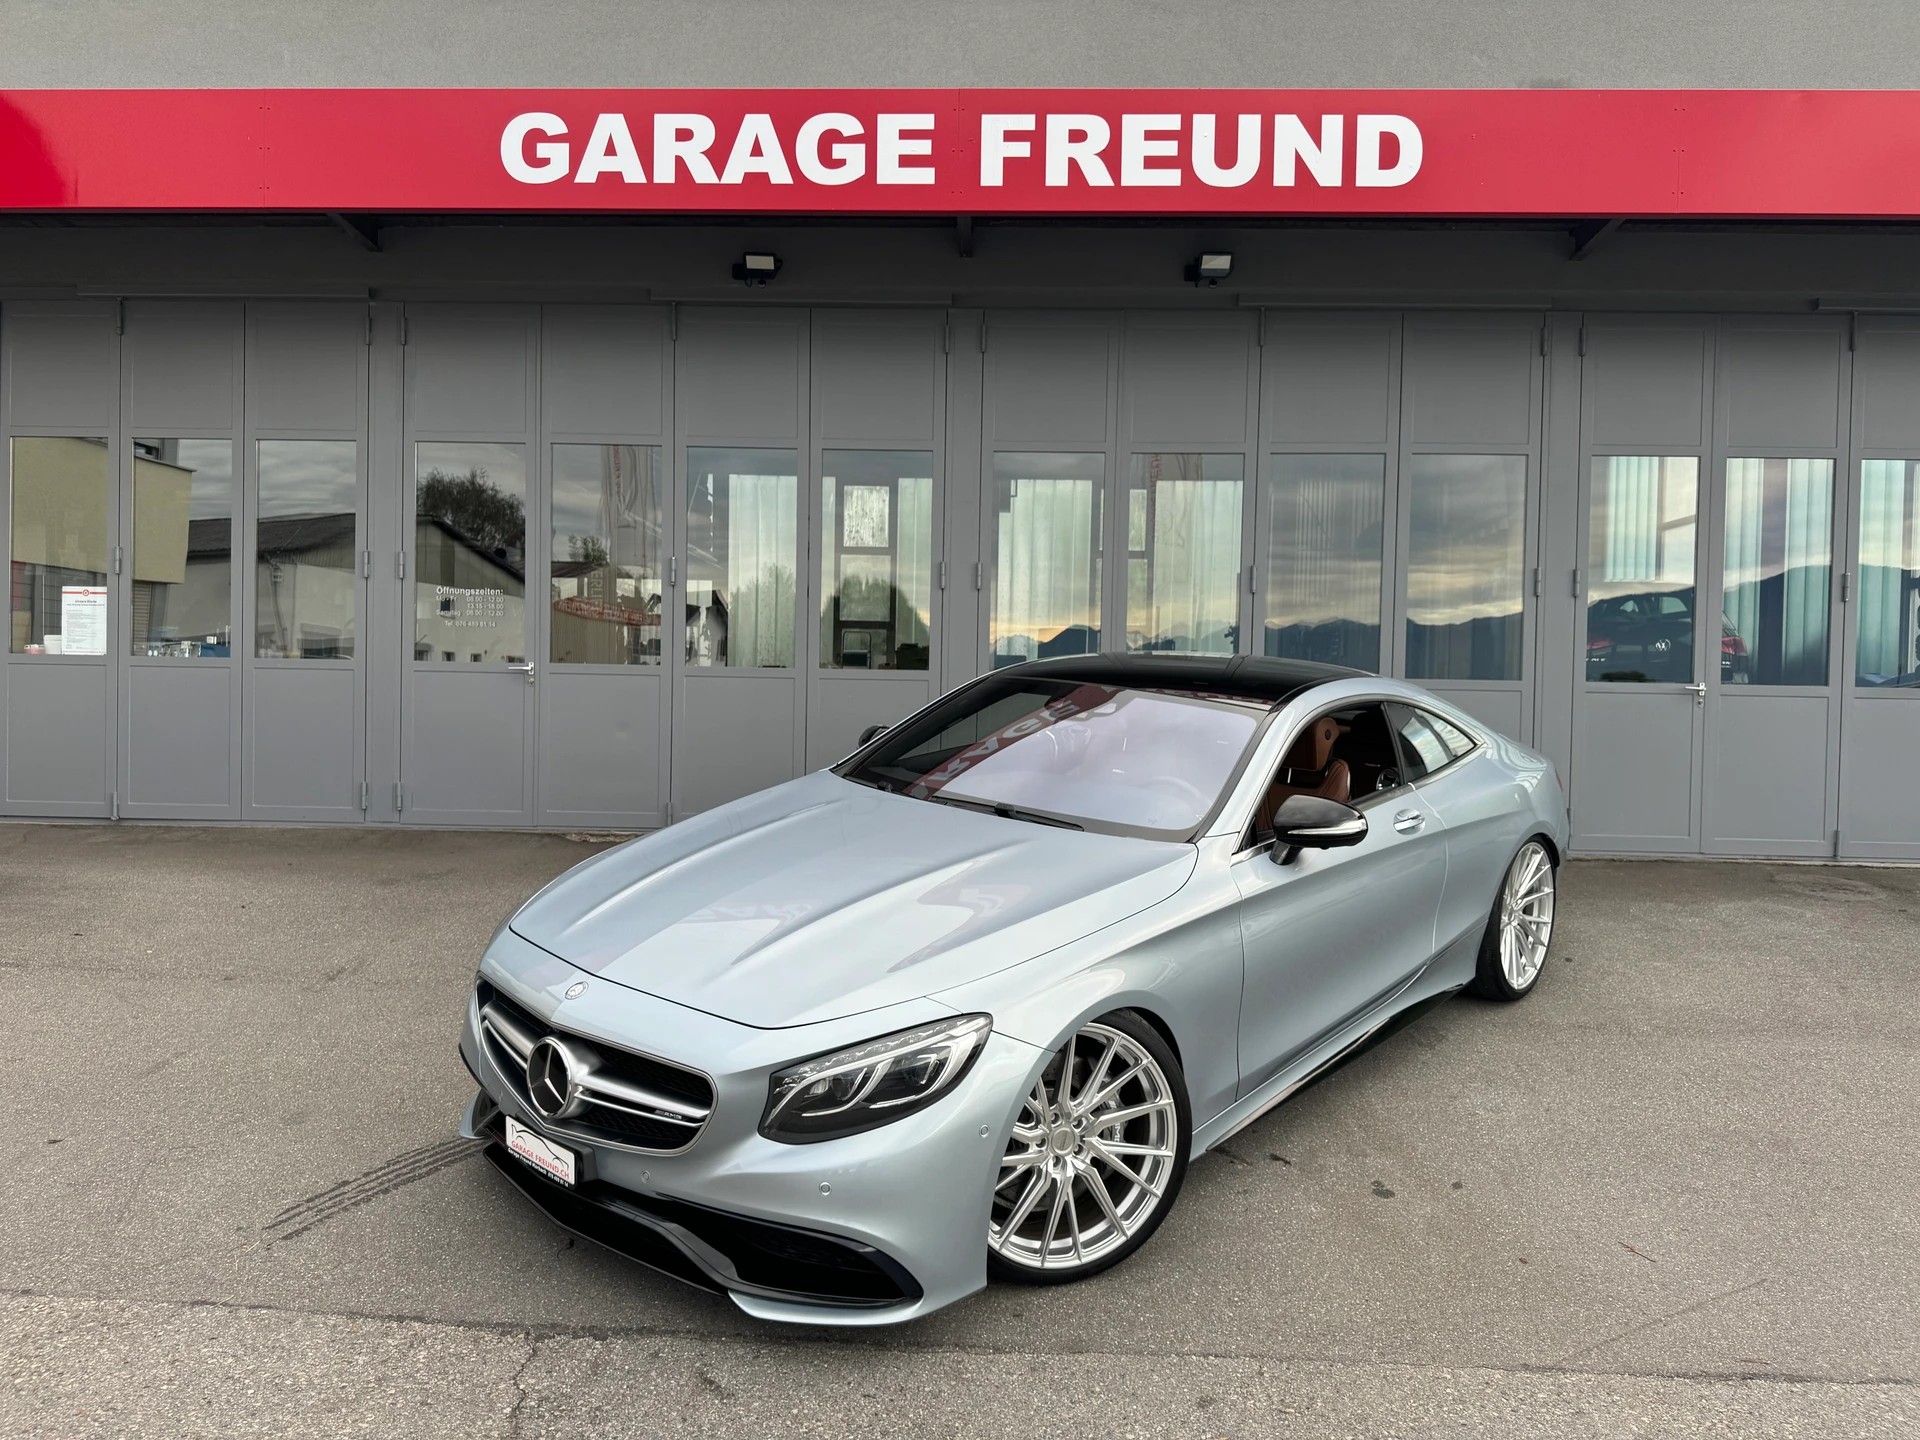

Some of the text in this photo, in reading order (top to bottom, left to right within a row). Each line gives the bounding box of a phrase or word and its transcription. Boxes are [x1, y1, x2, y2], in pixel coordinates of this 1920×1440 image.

[500, 112, 1423, 188] GARAGE FREUND
[436, 585, 504, 596] Öffnungszeiten:
[511, 1140, 569, 1179] GARAGE FREUND.CH
